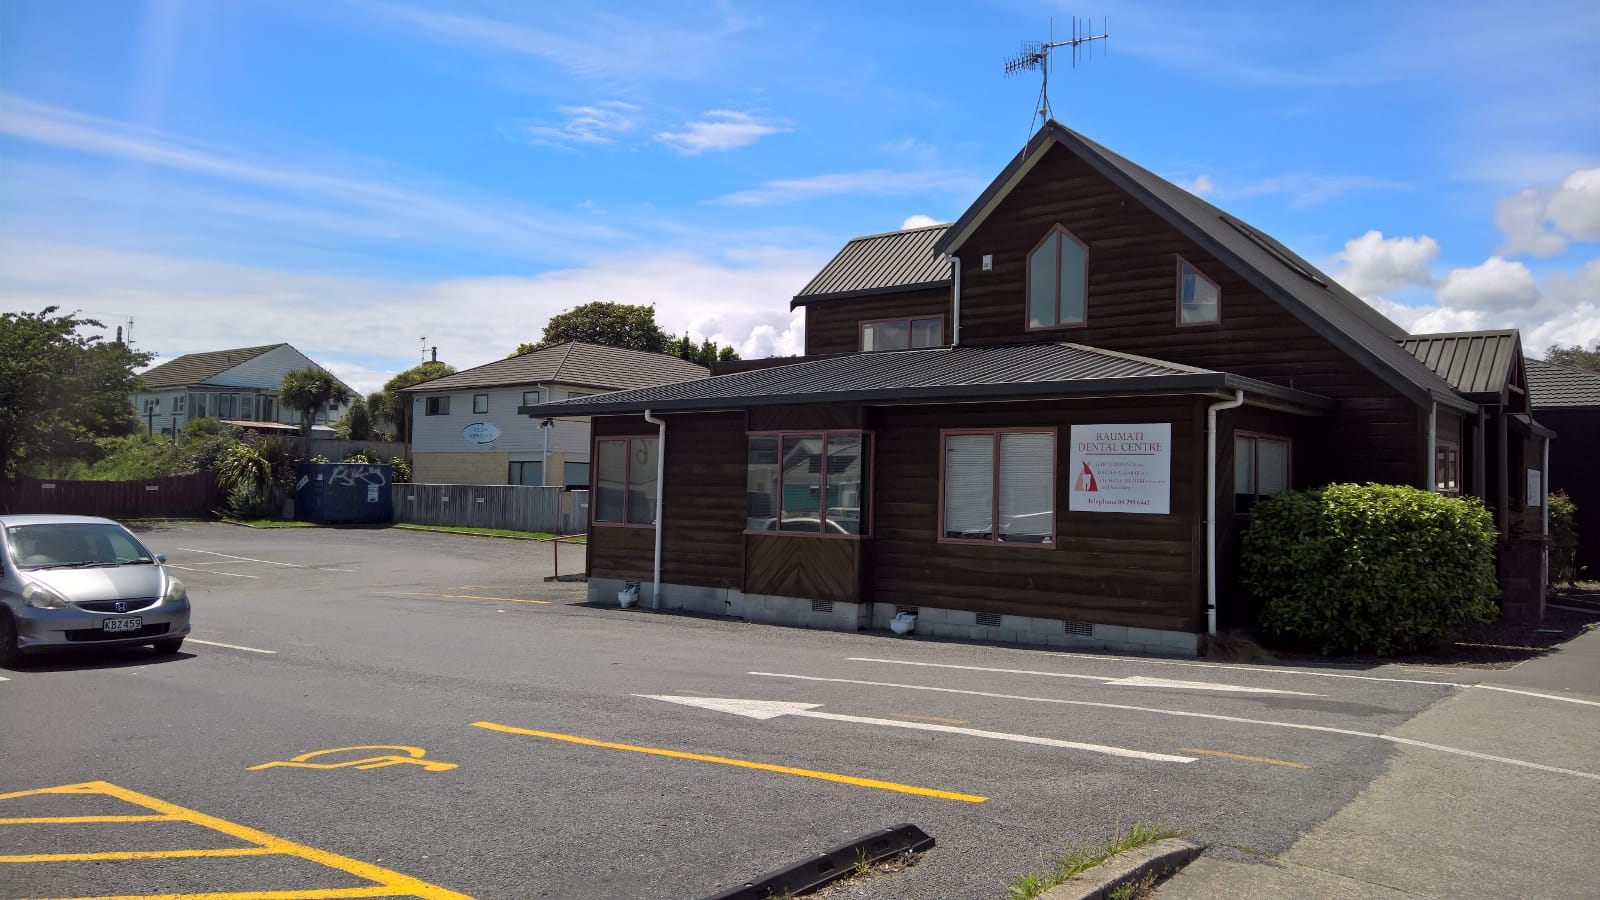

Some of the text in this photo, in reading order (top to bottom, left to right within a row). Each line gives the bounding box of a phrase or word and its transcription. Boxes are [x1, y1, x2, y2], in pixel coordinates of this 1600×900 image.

[1096, 432, 1143, 441] RAUMATI
[1078, 442, 1163, 452] DENTAL CENTRE
[105, 619, 141, 630] KBZ459
